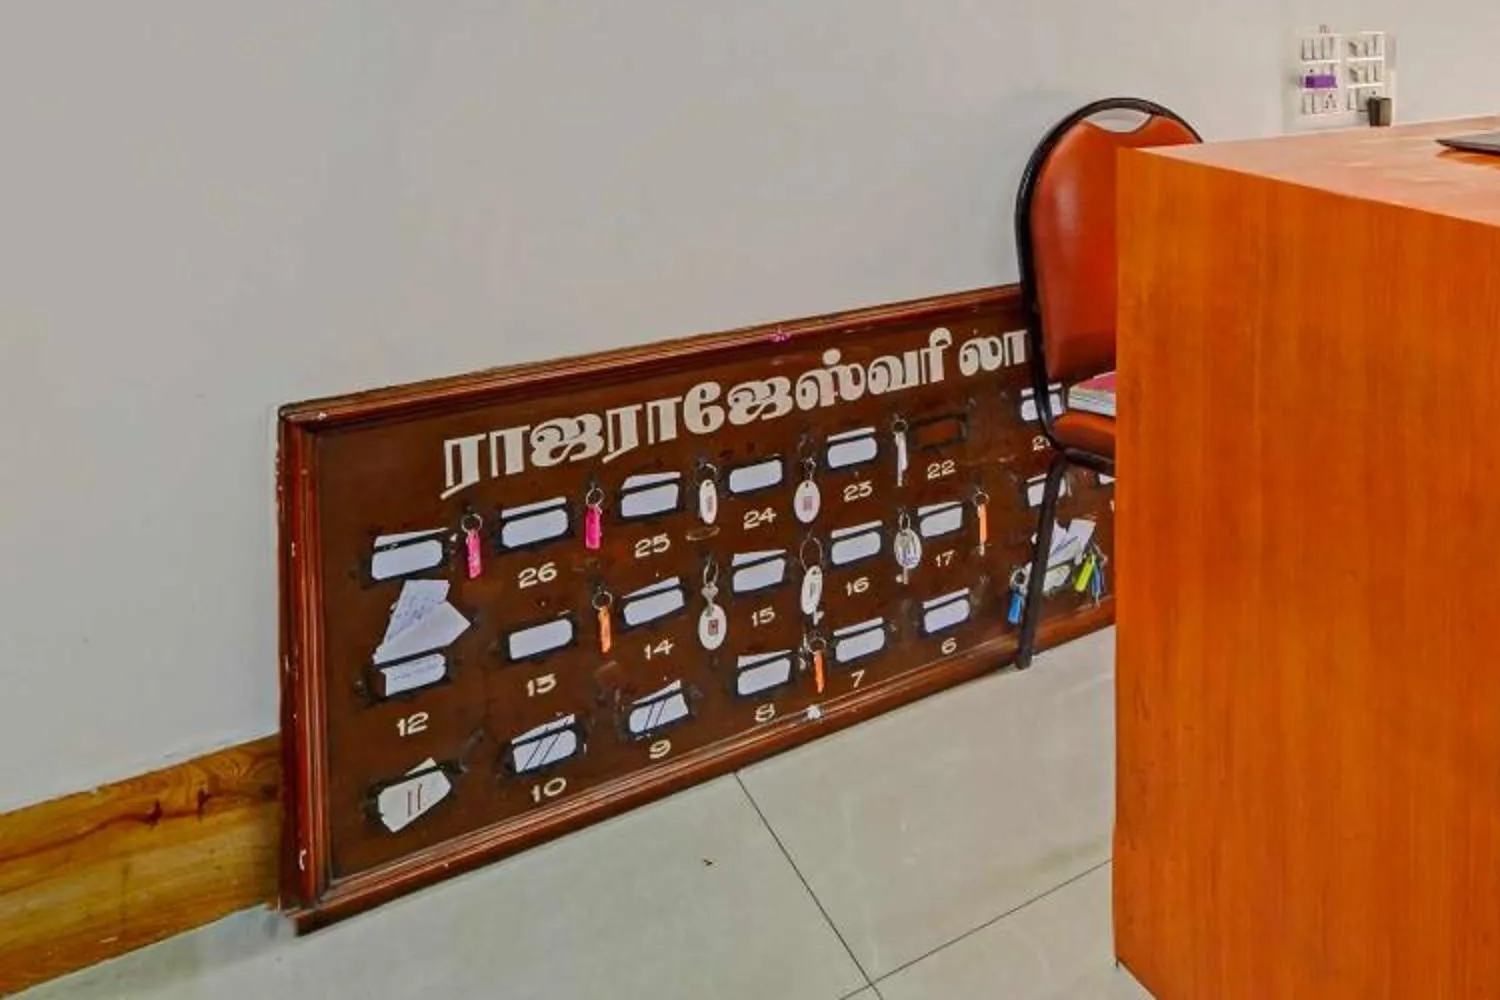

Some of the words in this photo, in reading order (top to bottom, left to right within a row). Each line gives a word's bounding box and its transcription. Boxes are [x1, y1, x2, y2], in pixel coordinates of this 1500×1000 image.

[958, 328, 1030, 378] லா
[926, 459, 957, 481] 22
[742, 506, 777, 531] 24
[634, 531, 672, 559] 25
[935, 550, 955, 567] 17
[517, 560, 558, 590] 26
[846, 576, 870, 597] 16
[751, 606, 775, 627] 15
[644, 639, 673, 661] 14
[941, 636, 957, 655] 6
[850, 669, 866, 689] 7
[754, 703, 775, 724] 8
[396, 711, 430, 739] 12
[650, 739, 671, 760] 9
[530, 775, 568, 804] 10
